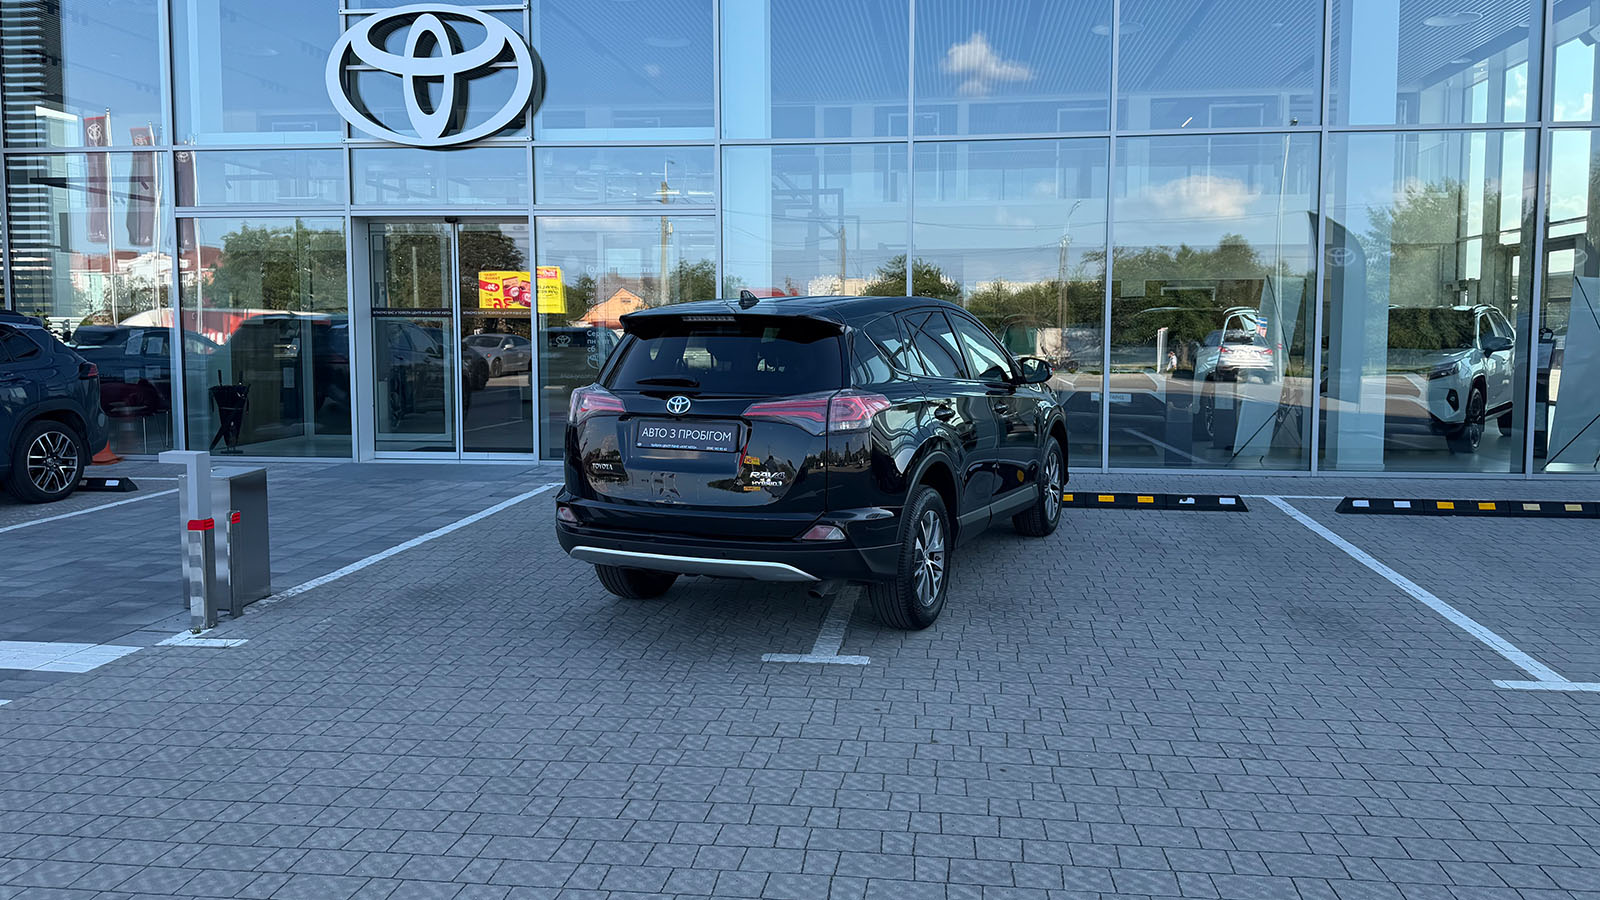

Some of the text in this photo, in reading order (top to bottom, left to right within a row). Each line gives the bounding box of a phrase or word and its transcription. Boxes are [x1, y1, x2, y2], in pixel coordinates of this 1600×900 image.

[641, 427, 732, 442] АВТО З ПРОБІГОМ
[591, 462, 614, 471] TOYOTA
[749, 471, 786, 480] RAV4
